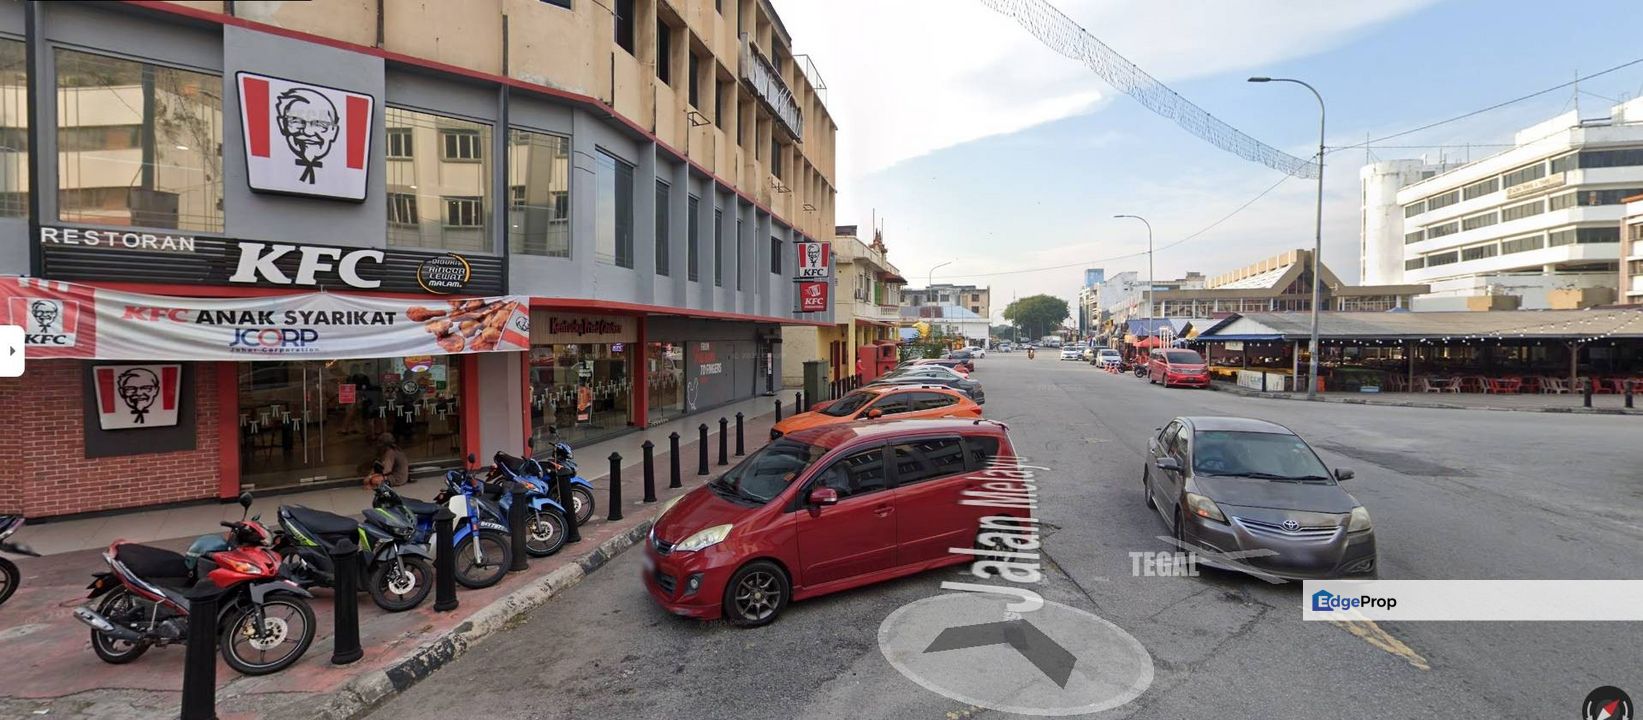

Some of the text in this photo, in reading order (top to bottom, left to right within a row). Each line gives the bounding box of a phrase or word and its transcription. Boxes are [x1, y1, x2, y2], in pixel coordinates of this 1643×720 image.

[40, 226, 196, 253] RESTORAN
[229, 241, 385, 289] KFC
[803, 268, 825, 277] KFC
[805, 297, 825, 305] KFC
[121, 304, 398, 326] KFC ANAK SYARIKAT
[25, 333, 67, 345] KFC
[229, 328, 319, 348] JCORP
